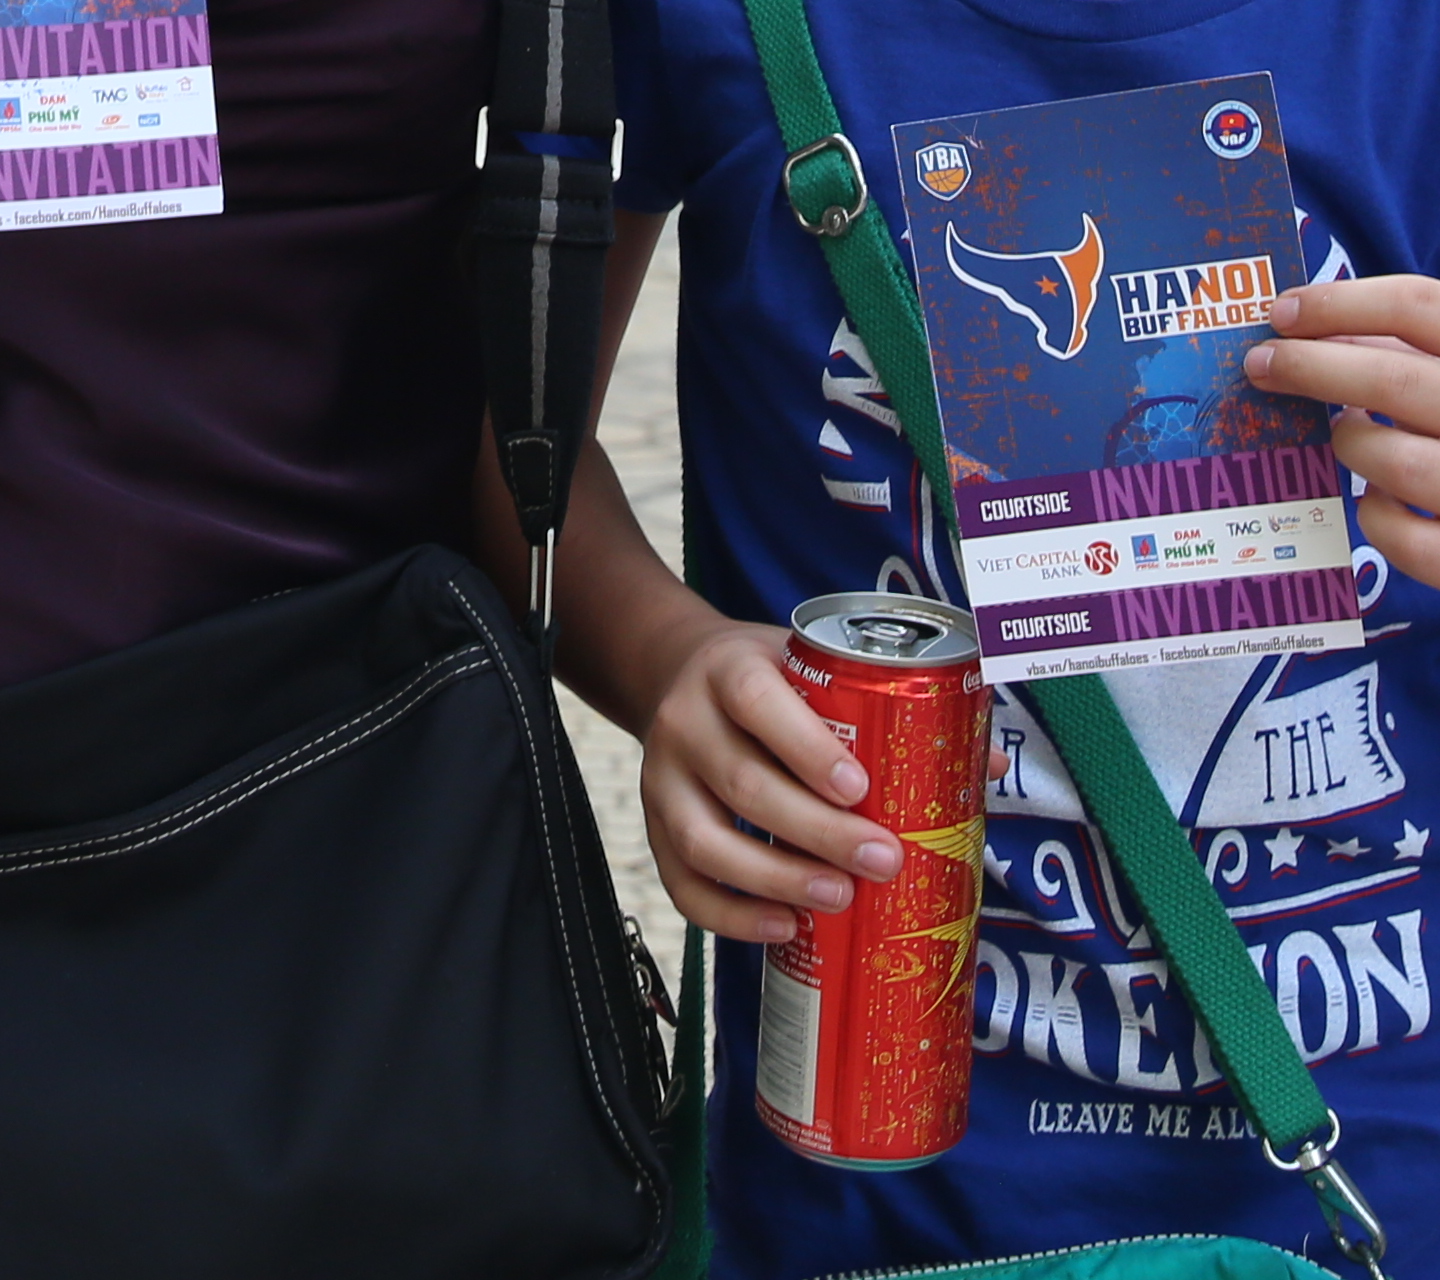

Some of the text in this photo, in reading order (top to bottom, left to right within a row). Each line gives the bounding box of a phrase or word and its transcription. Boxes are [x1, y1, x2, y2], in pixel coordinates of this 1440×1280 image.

[92, 87, 129, 104] TMG
[28, 104, 56, 124] PHÚ
[920, 146, 963, 171] VBA
[14, 201, 183, 227] facebook.com/HanoiBuffaloes
[1116, 259, 1274, 315] HANOI
[1123, 300, 1275, 338] BUFFALOES
[980, 445, 1339, 525] COURTSIDE INVITATION
[1225, 519, 1262, 537] TMG
[977, 550, 1081, 573] VIET CAPITAL
[1164, 540, 1192, 560] PHÚ
[1041, 564, 1083, 580] BANK
[1000, 567, 1360, 642] COURTSIDE INVITATION
[1026, 651, 1150, 678] vba.vn/hanoibuffaloes
[1159, 635, 1325, 662] facebook.com/HanoiBuffaloes
[802, 665, 833, 688] KHÁT
[1254, 711, 1348, 803] THE
[1028, 1097, 1135, 1136] (LEAVE
[1145, 1102, 1192, 1138] ME
